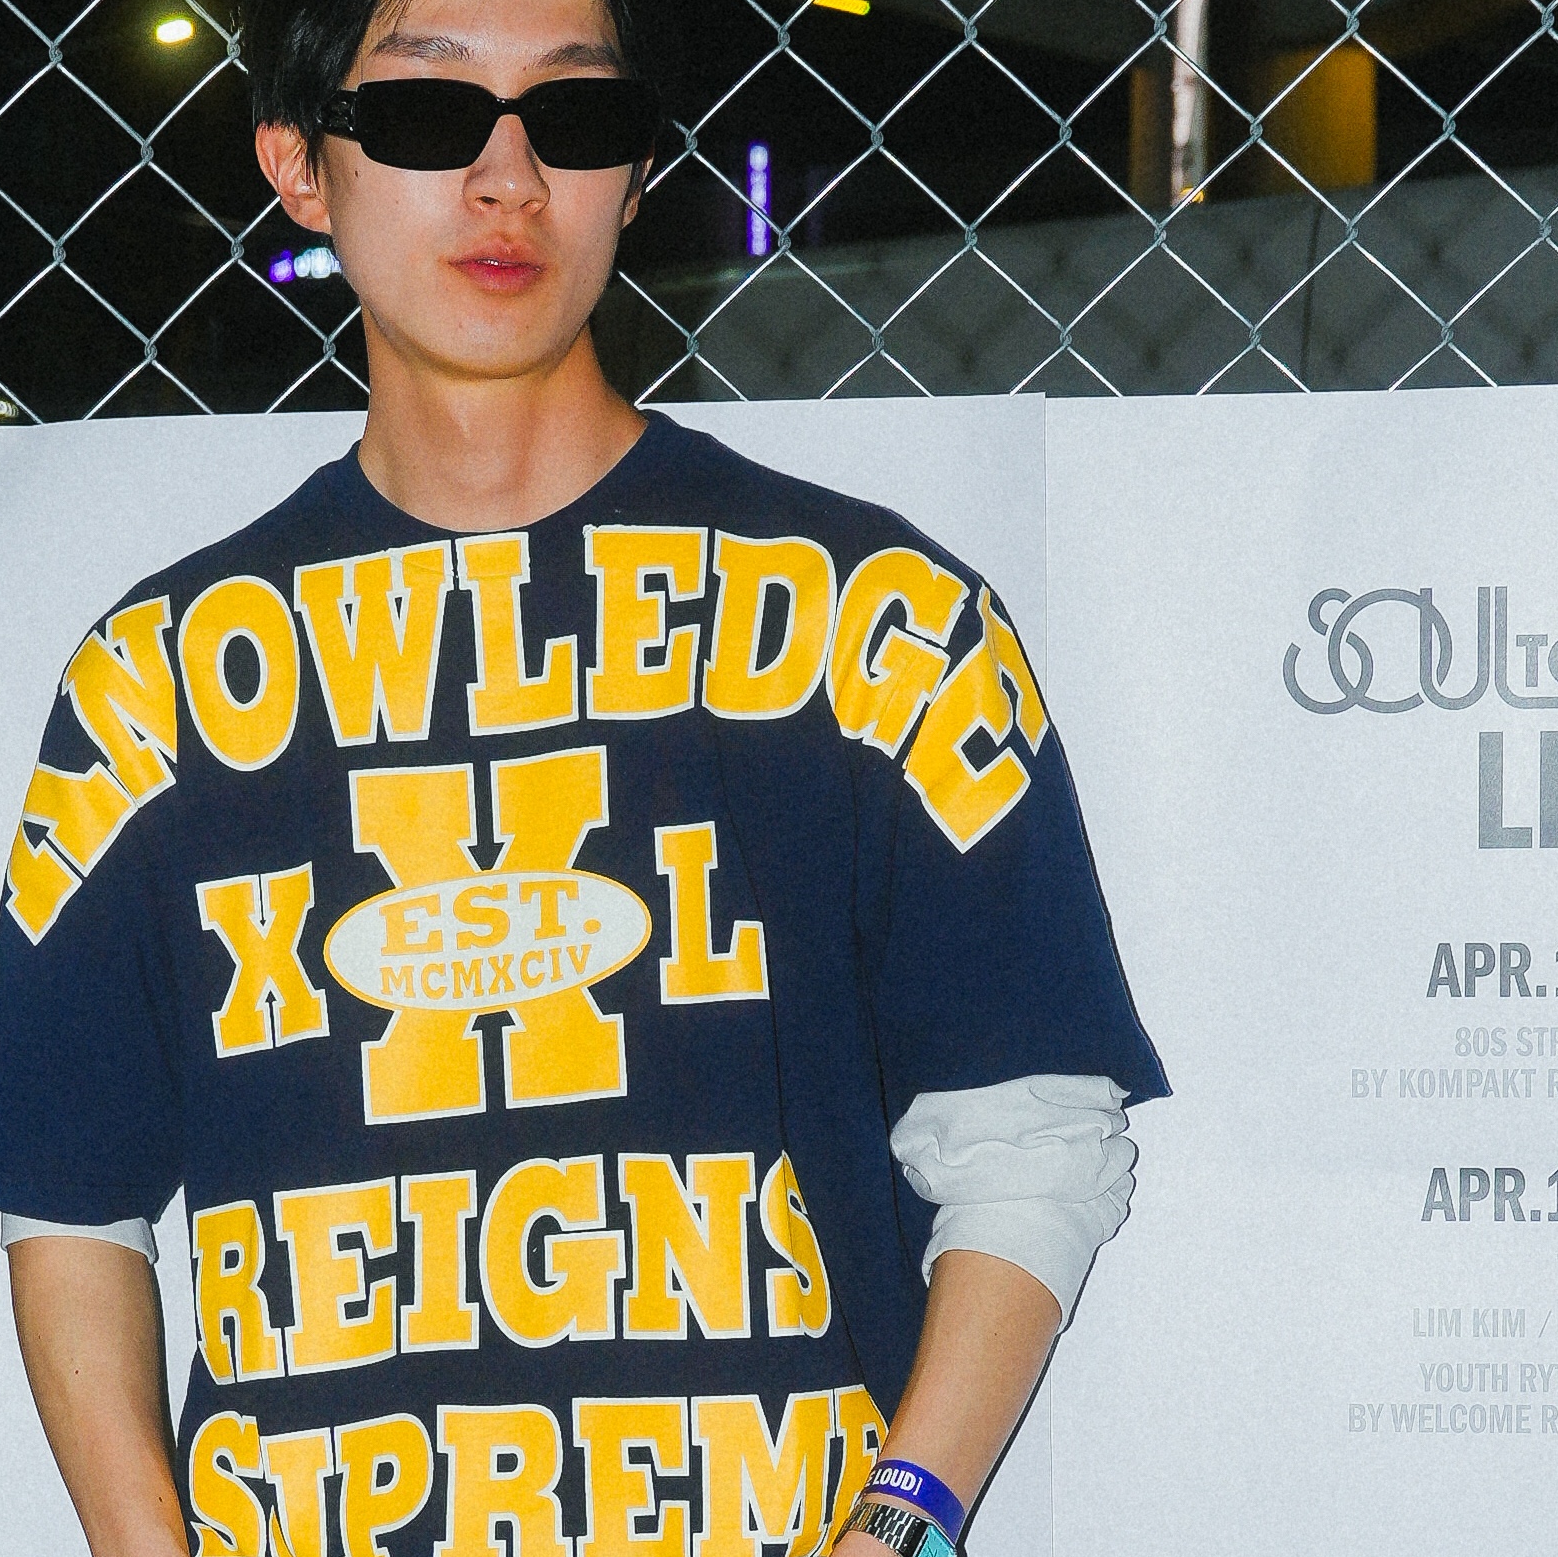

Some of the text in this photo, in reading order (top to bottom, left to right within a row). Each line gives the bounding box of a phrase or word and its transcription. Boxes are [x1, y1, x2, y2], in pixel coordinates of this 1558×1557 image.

[379, 880, 602, 955] EST.
[379, 942, 594, 1001] MCMXCIV
[1455, 1027, 1507, 1057] 80S
[1352, 1069, 1388, 1098] BY
[1400, 1069, 1536, 1098] KOMPAKT
[192, 1149, 833, 1385] REIGNS
[1413, 1308, 1461, 1338] LIM
[1473, 1309, 1525, 1338] KIM
[1421, 1363, 1508, 1393] YOUTH
[1348, 1404, 1384, 1433] BY
[1391, 1403, 1531, 1434] WELCOME
